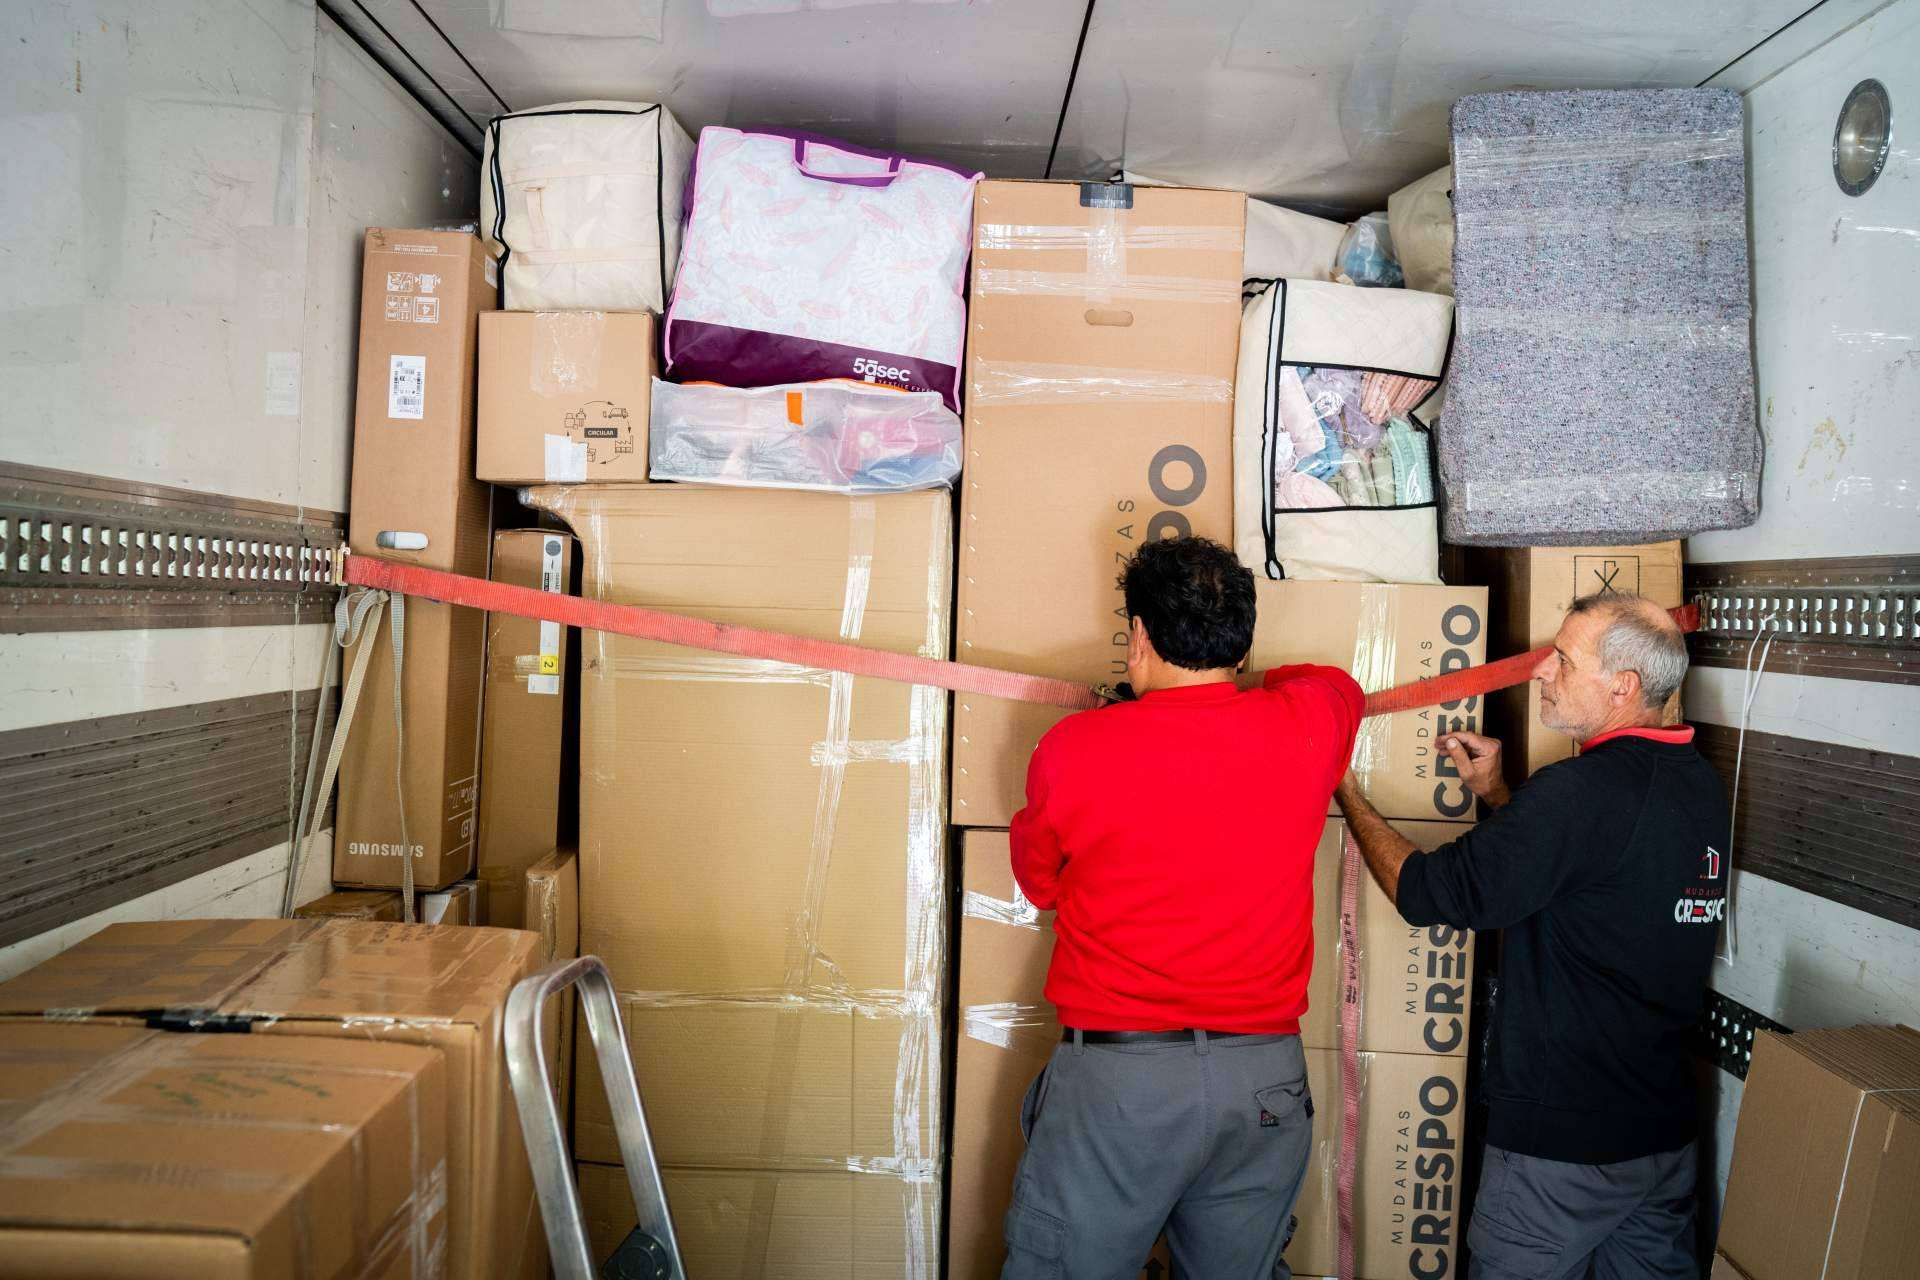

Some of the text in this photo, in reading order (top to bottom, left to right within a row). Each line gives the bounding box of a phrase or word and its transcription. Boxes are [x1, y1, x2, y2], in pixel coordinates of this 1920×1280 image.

[544, 660, 554, 669] 2
[1405, 928, 1421, 1014] MUDAN
[1423, 924, 1468, 1053] CRES
[1391, 1110, 1411, 1245] MUDANZAS
[1408, 1075, 1459, 1280] CRESPO
